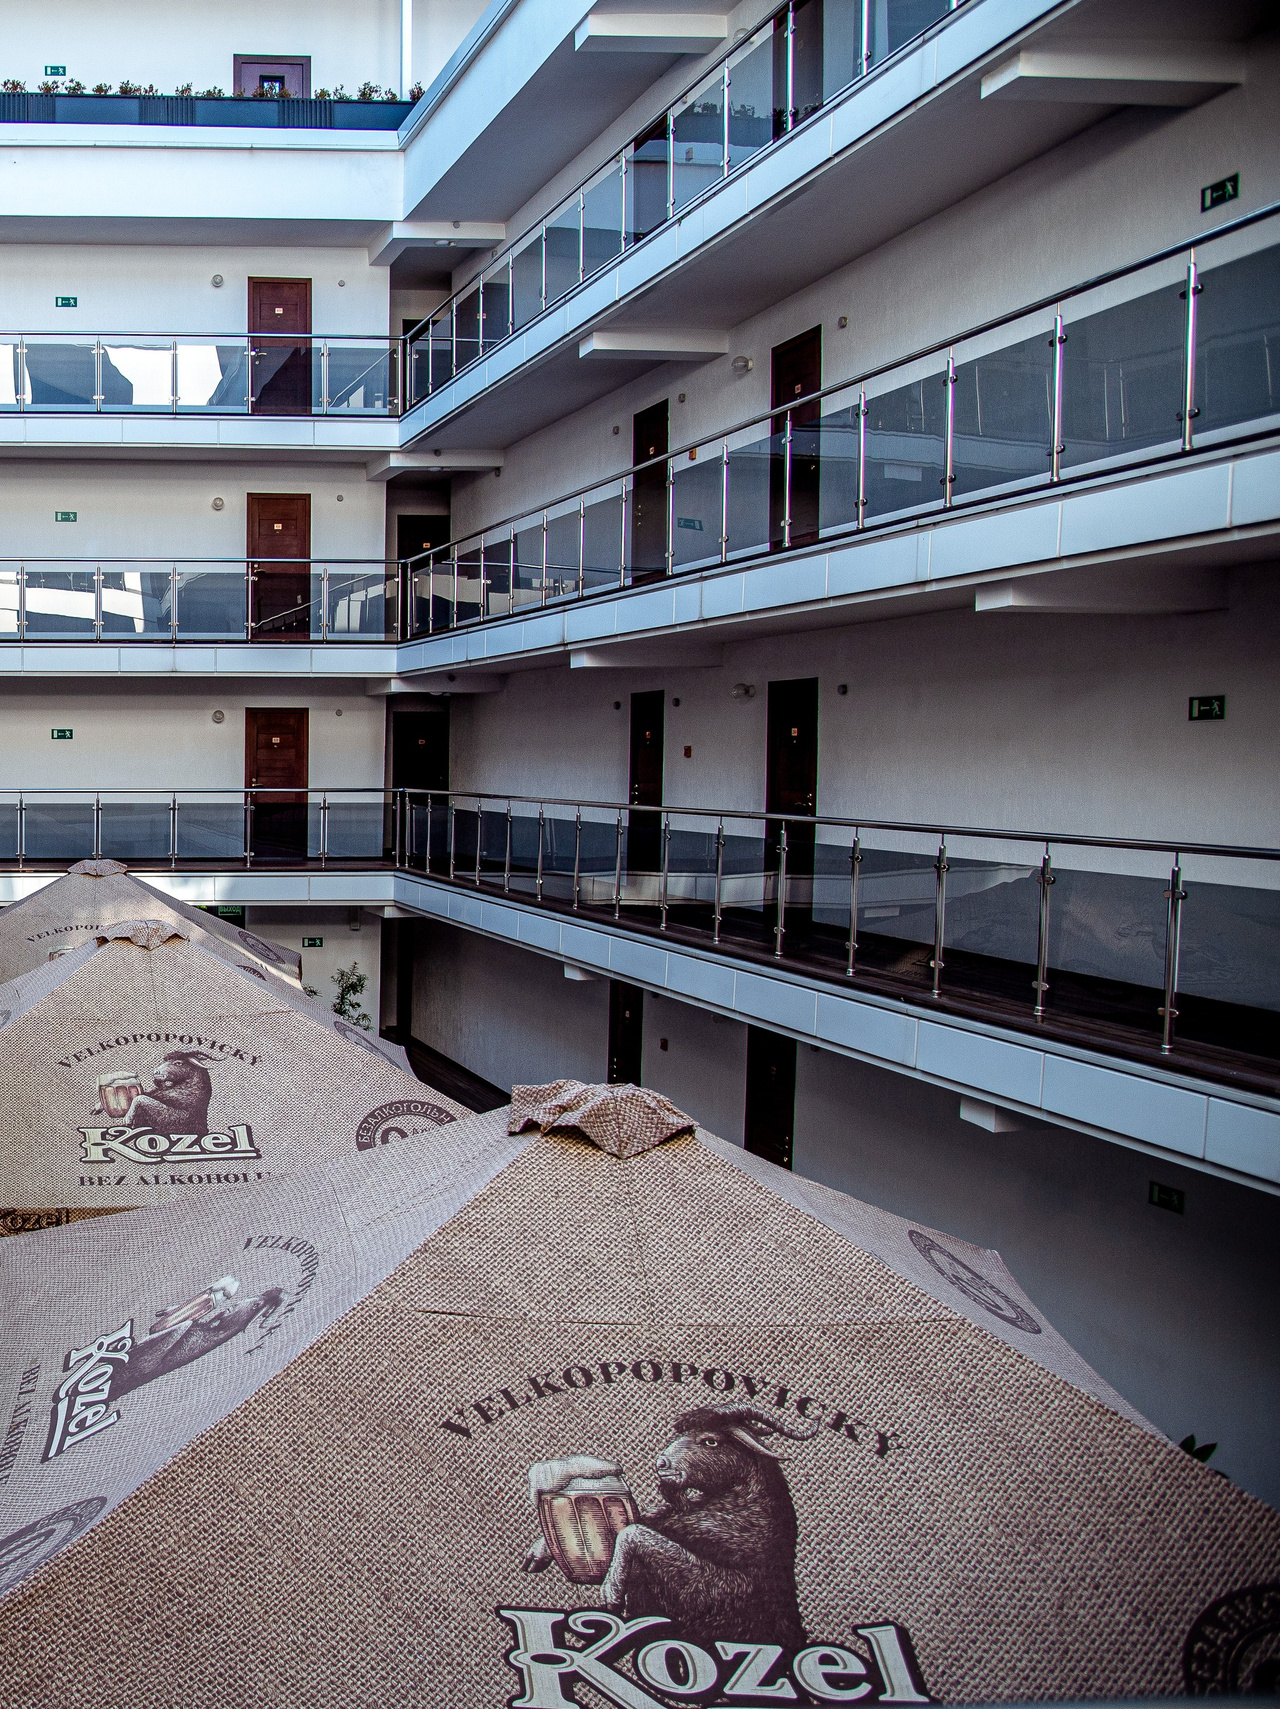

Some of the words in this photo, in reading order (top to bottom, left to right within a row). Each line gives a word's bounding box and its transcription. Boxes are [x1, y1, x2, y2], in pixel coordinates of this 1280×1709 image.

[78, 1124, 262, 1164] Kozel
[79, 1175, 128, 1187] BEZ
[41, 1318, 134, 1463] Kozel
[496, 1604, 933, 1709] Kozel
